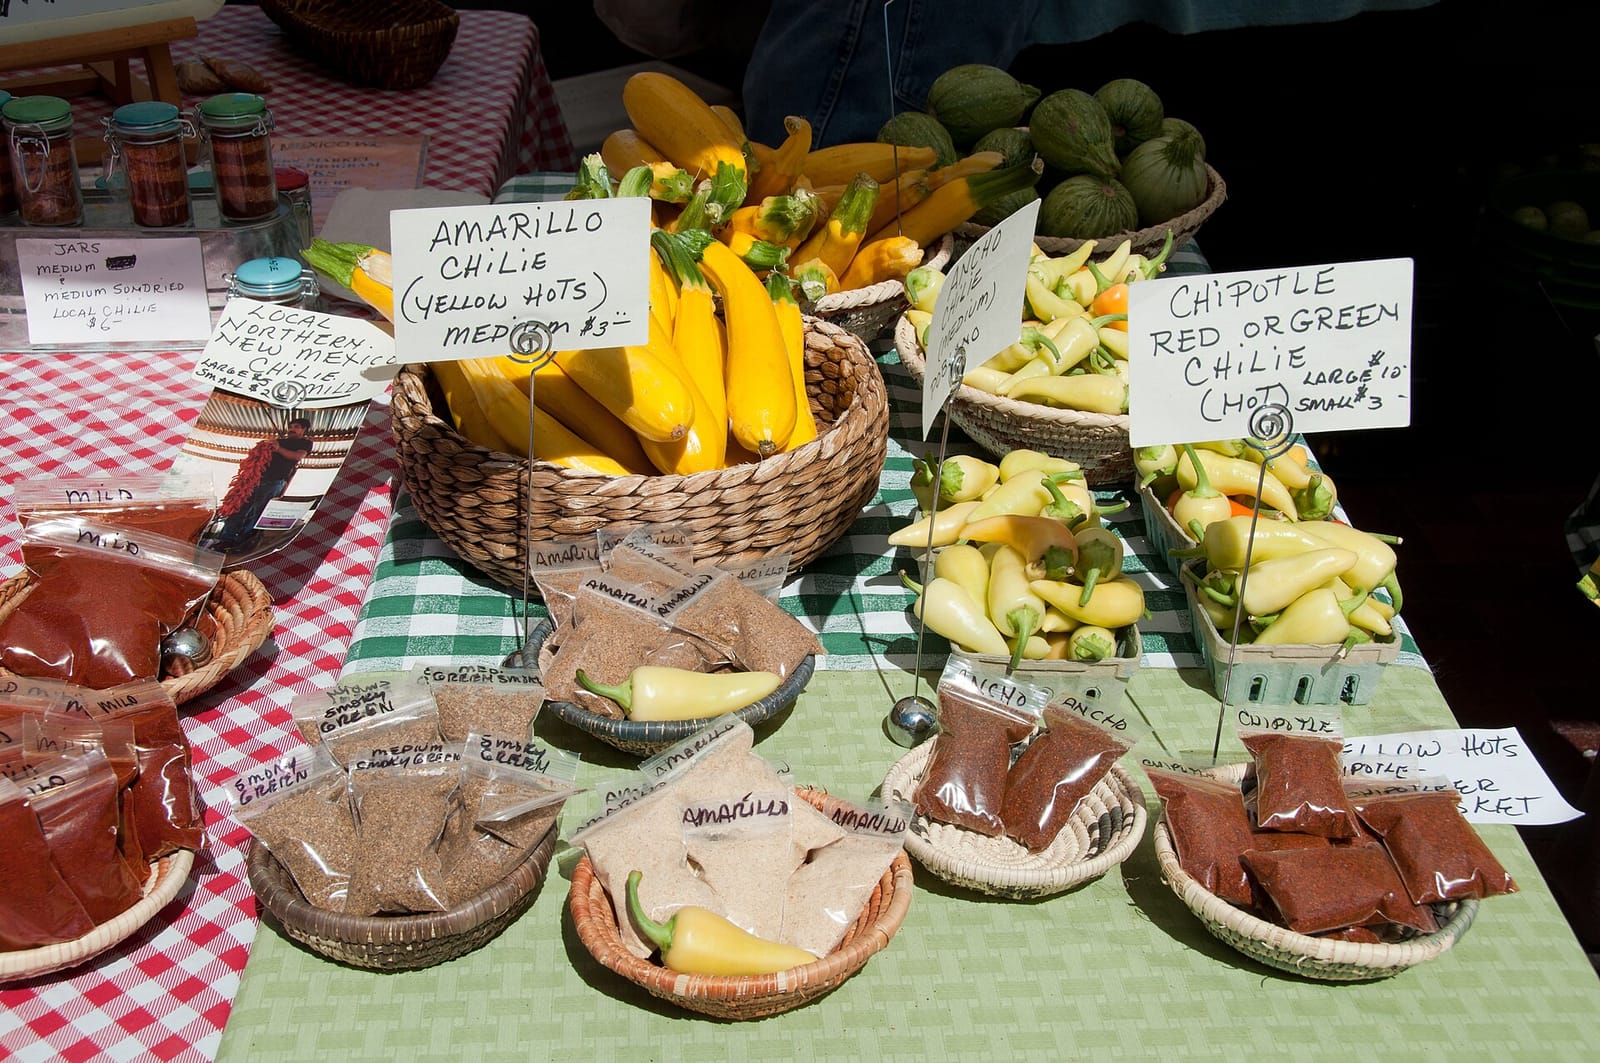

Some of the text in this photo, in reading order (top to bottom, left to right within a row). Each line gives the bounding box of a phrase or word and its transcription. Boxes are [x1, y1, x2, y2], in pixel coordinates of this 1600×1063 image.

[428, 205, 603, 252] AMARILLO
[54, 242, 101, 256] JARS
[36, 262, 97, 277] MEDIUM
[440, 247, 547, 280] CHILIE
[948, 229, 1002, 298] ANCHO
[43, 287, 108, 303] MEDIUM
[940, 267, 983, 332] CHILIE
[1169, 266, 1337, 319] CHIPOTLE
[52, 302, 158, 320] LOCAL CHILIE
[247, 304, 331, 330] LOCAL
[442, 315, 570, 347] MEDM
[1149, 302, 1399, 357] RED OR GREEN
[214, 331, 283, 357] NEW
[200, 358, 250, 379] LARGE
[929, 325, 980, 400] POBNO
[1184, 343, 1307, 387] CHILIE
[1302, 367, 1373, 386] LARGE
[195, 368, 244, 390] SMALL
[297, 381, 361, 397] MILD
[1294, 395, 1355, 413] SMALL
[65, 483, 134, 505] MILD
[76, 527, 140, 556] MILD
[534, 543, 601, 567] AMARILL
[736, 561, 785, 582] ARILLO
[432, 671, 495, 684] GREEN
[957, 668, 1028, 709] ANCHO
[320, 700, 395, 734] GREEN
[1061, 696, 1128, 731] ANCHO
[1460, 733, 1519, 758] HOTS
[480, 749, 550, 774] GREEN
[1342, 762, 1409, 779] IPOTLE
[239, 769, 308, 806] GREEN
[1453, 778, 1500, 795] ER
[682, 790, 789, 828] AMARILLO
[1458, 796, 1543, 817] SKET
